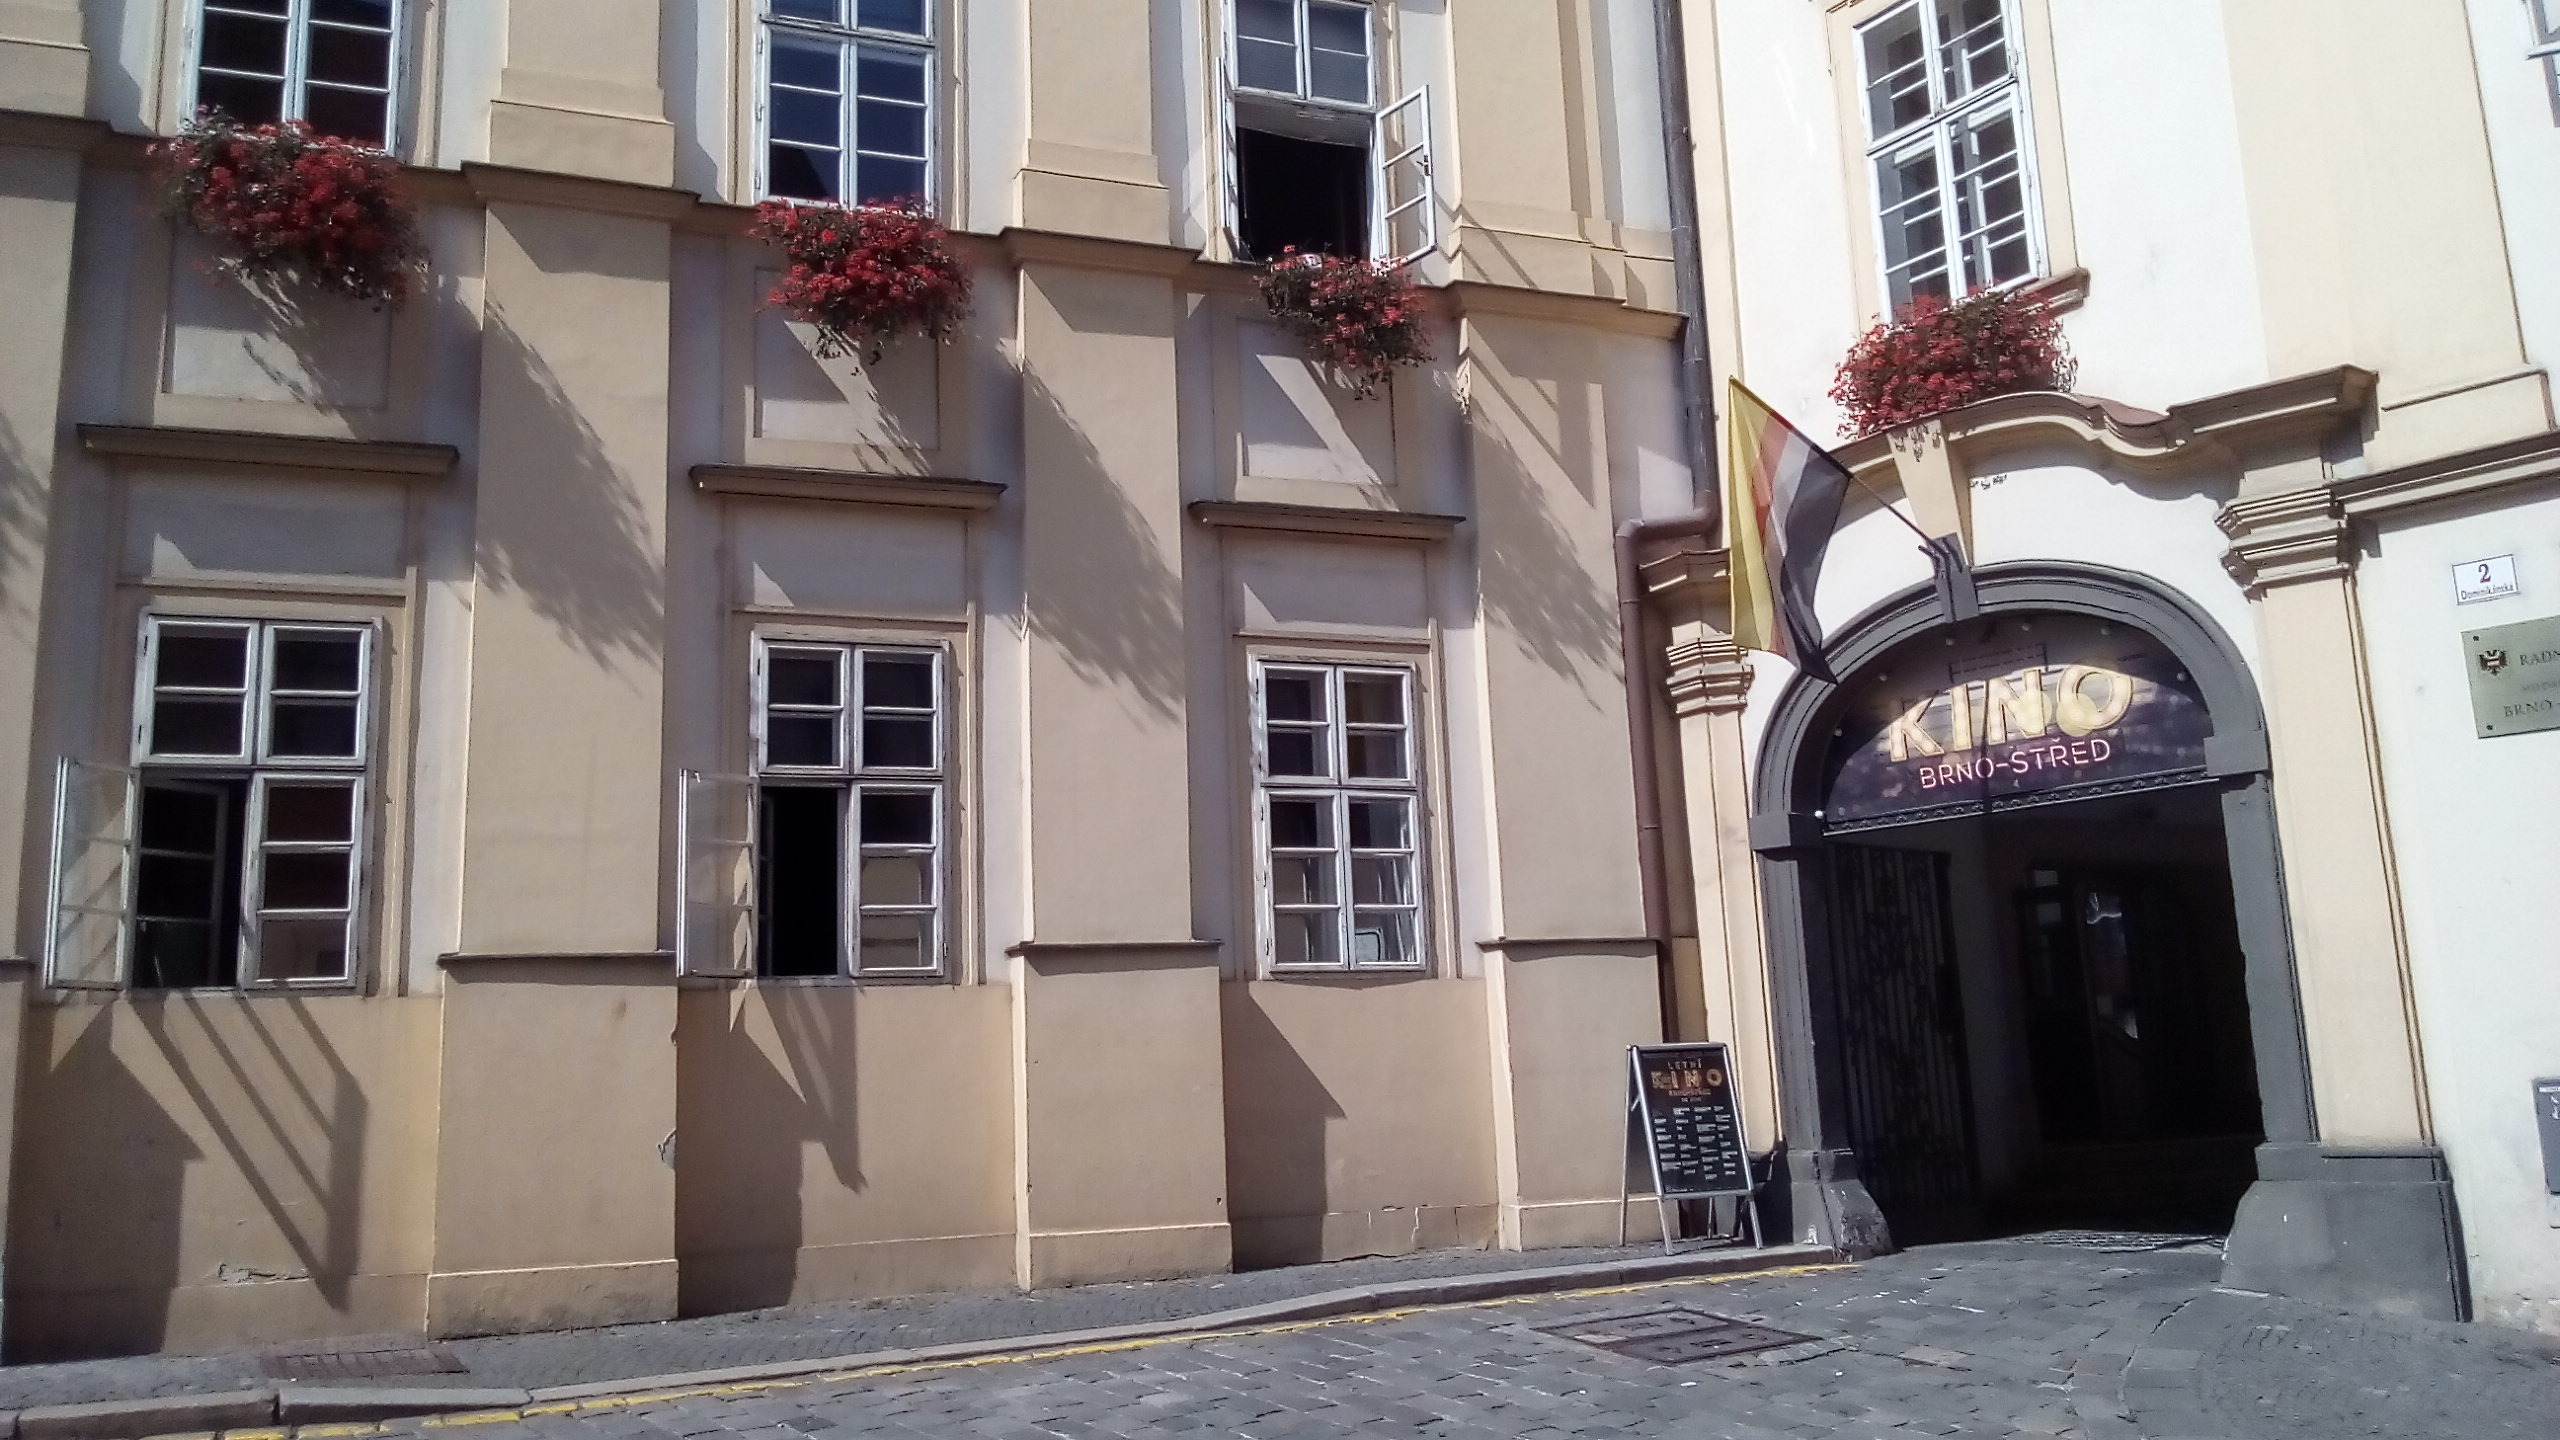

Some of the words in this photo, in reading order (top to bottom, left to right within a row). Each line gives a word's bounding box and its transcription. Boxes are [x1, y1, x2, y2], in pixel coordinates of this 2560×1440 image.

[2478, 563, 2491, 583] 2
[1888, 665, 2134, 763] KINO
[2503, 698, 2553, 718] BRNO
[1919, 738, 2111, 790] BRNO-STŘED
[1651, 1068, 1722, 1089] KINO
